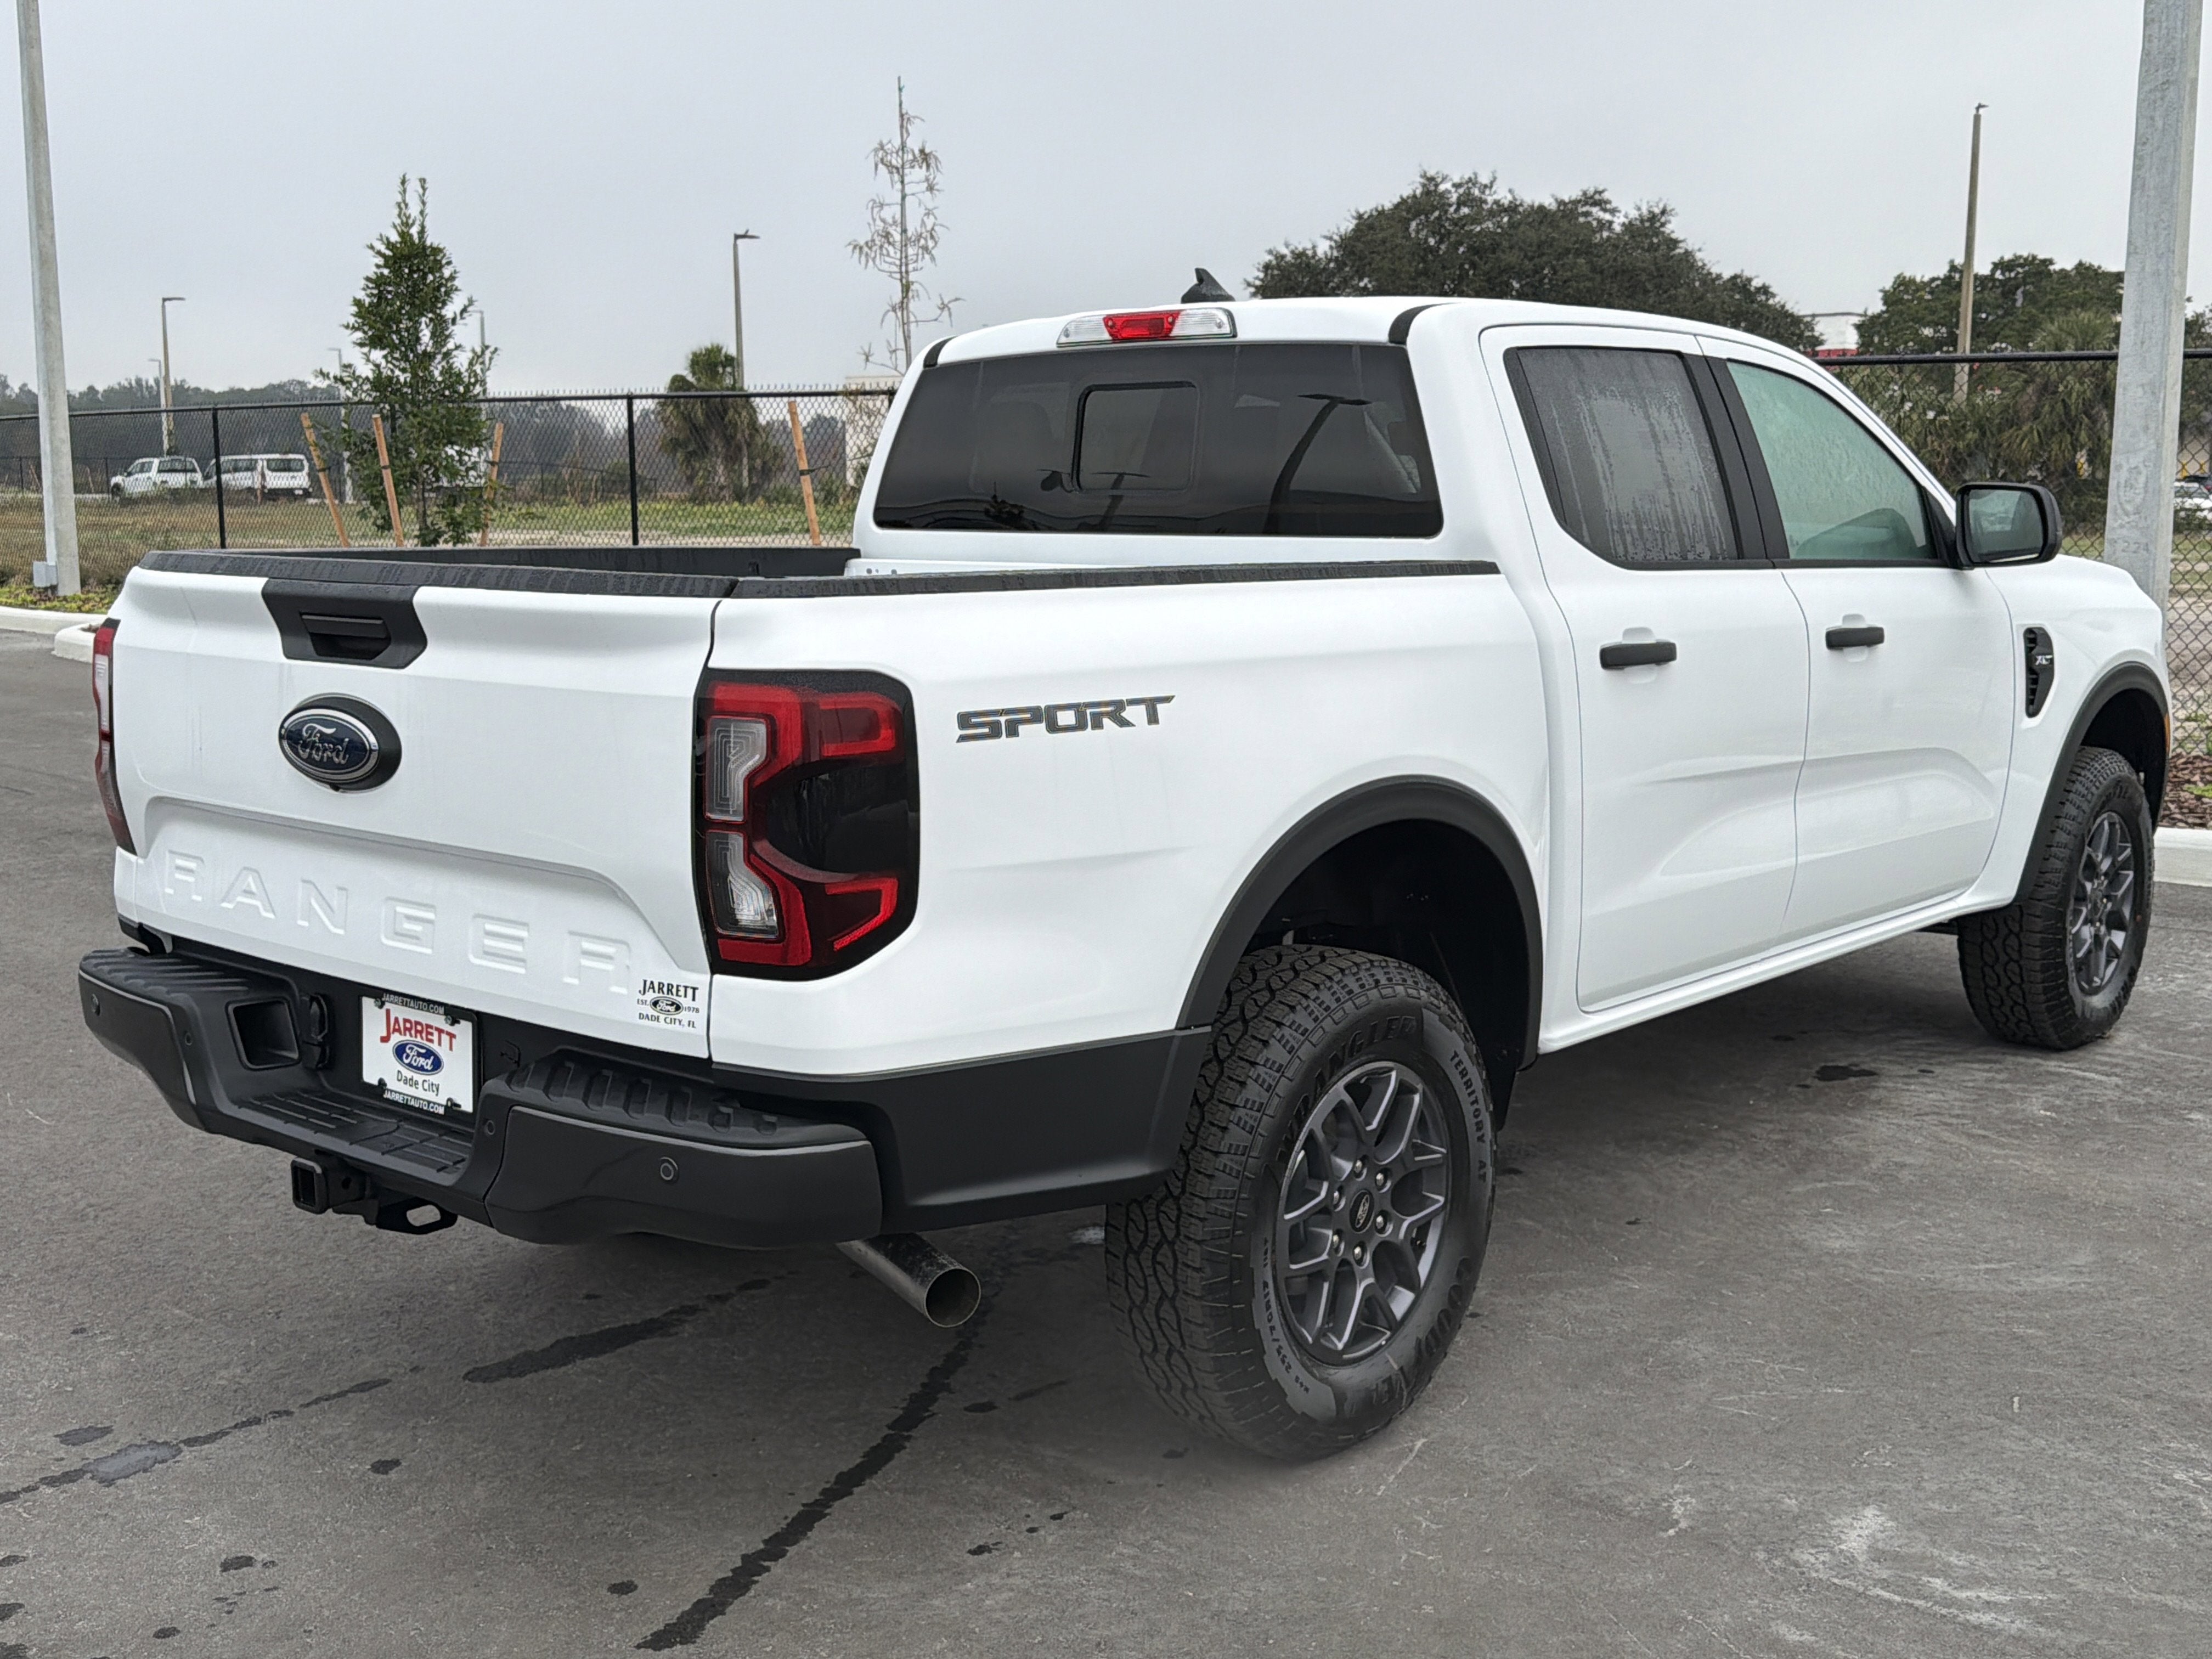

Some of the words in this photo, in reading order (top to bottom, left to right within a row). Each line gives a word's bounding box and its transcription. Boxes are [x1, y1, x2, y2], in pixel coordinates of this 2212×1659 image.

[956, 695, 1176, 743] SPORT
[298, 723, 349, 765] Ford
[165, 849, 631, 995] RANGER
[382, 992, 445, 1015] JARRETTAUTO.COM
[636, 998, 649, 1006] EST.
[638, 979, 699, 1002] JARRETT
[380, 1008, 457, 1052] JARRETT
[638, 1012, 662, 1023] DADE
[664, 1017, 685, 1028] CITY,
[687, 1020, 697, 1029] FL
[402, 1043, 435, 1070] Ford
[396, 1070, 420, 1090] Dade
[422, 1079, 440, 1097] City
[383, 1090, 445, 1115] JARRETTAUTO.COM
[1449, 1050, 1486, 1143] TERRITORY
[1477, 1159, 1487, 1183] AT
